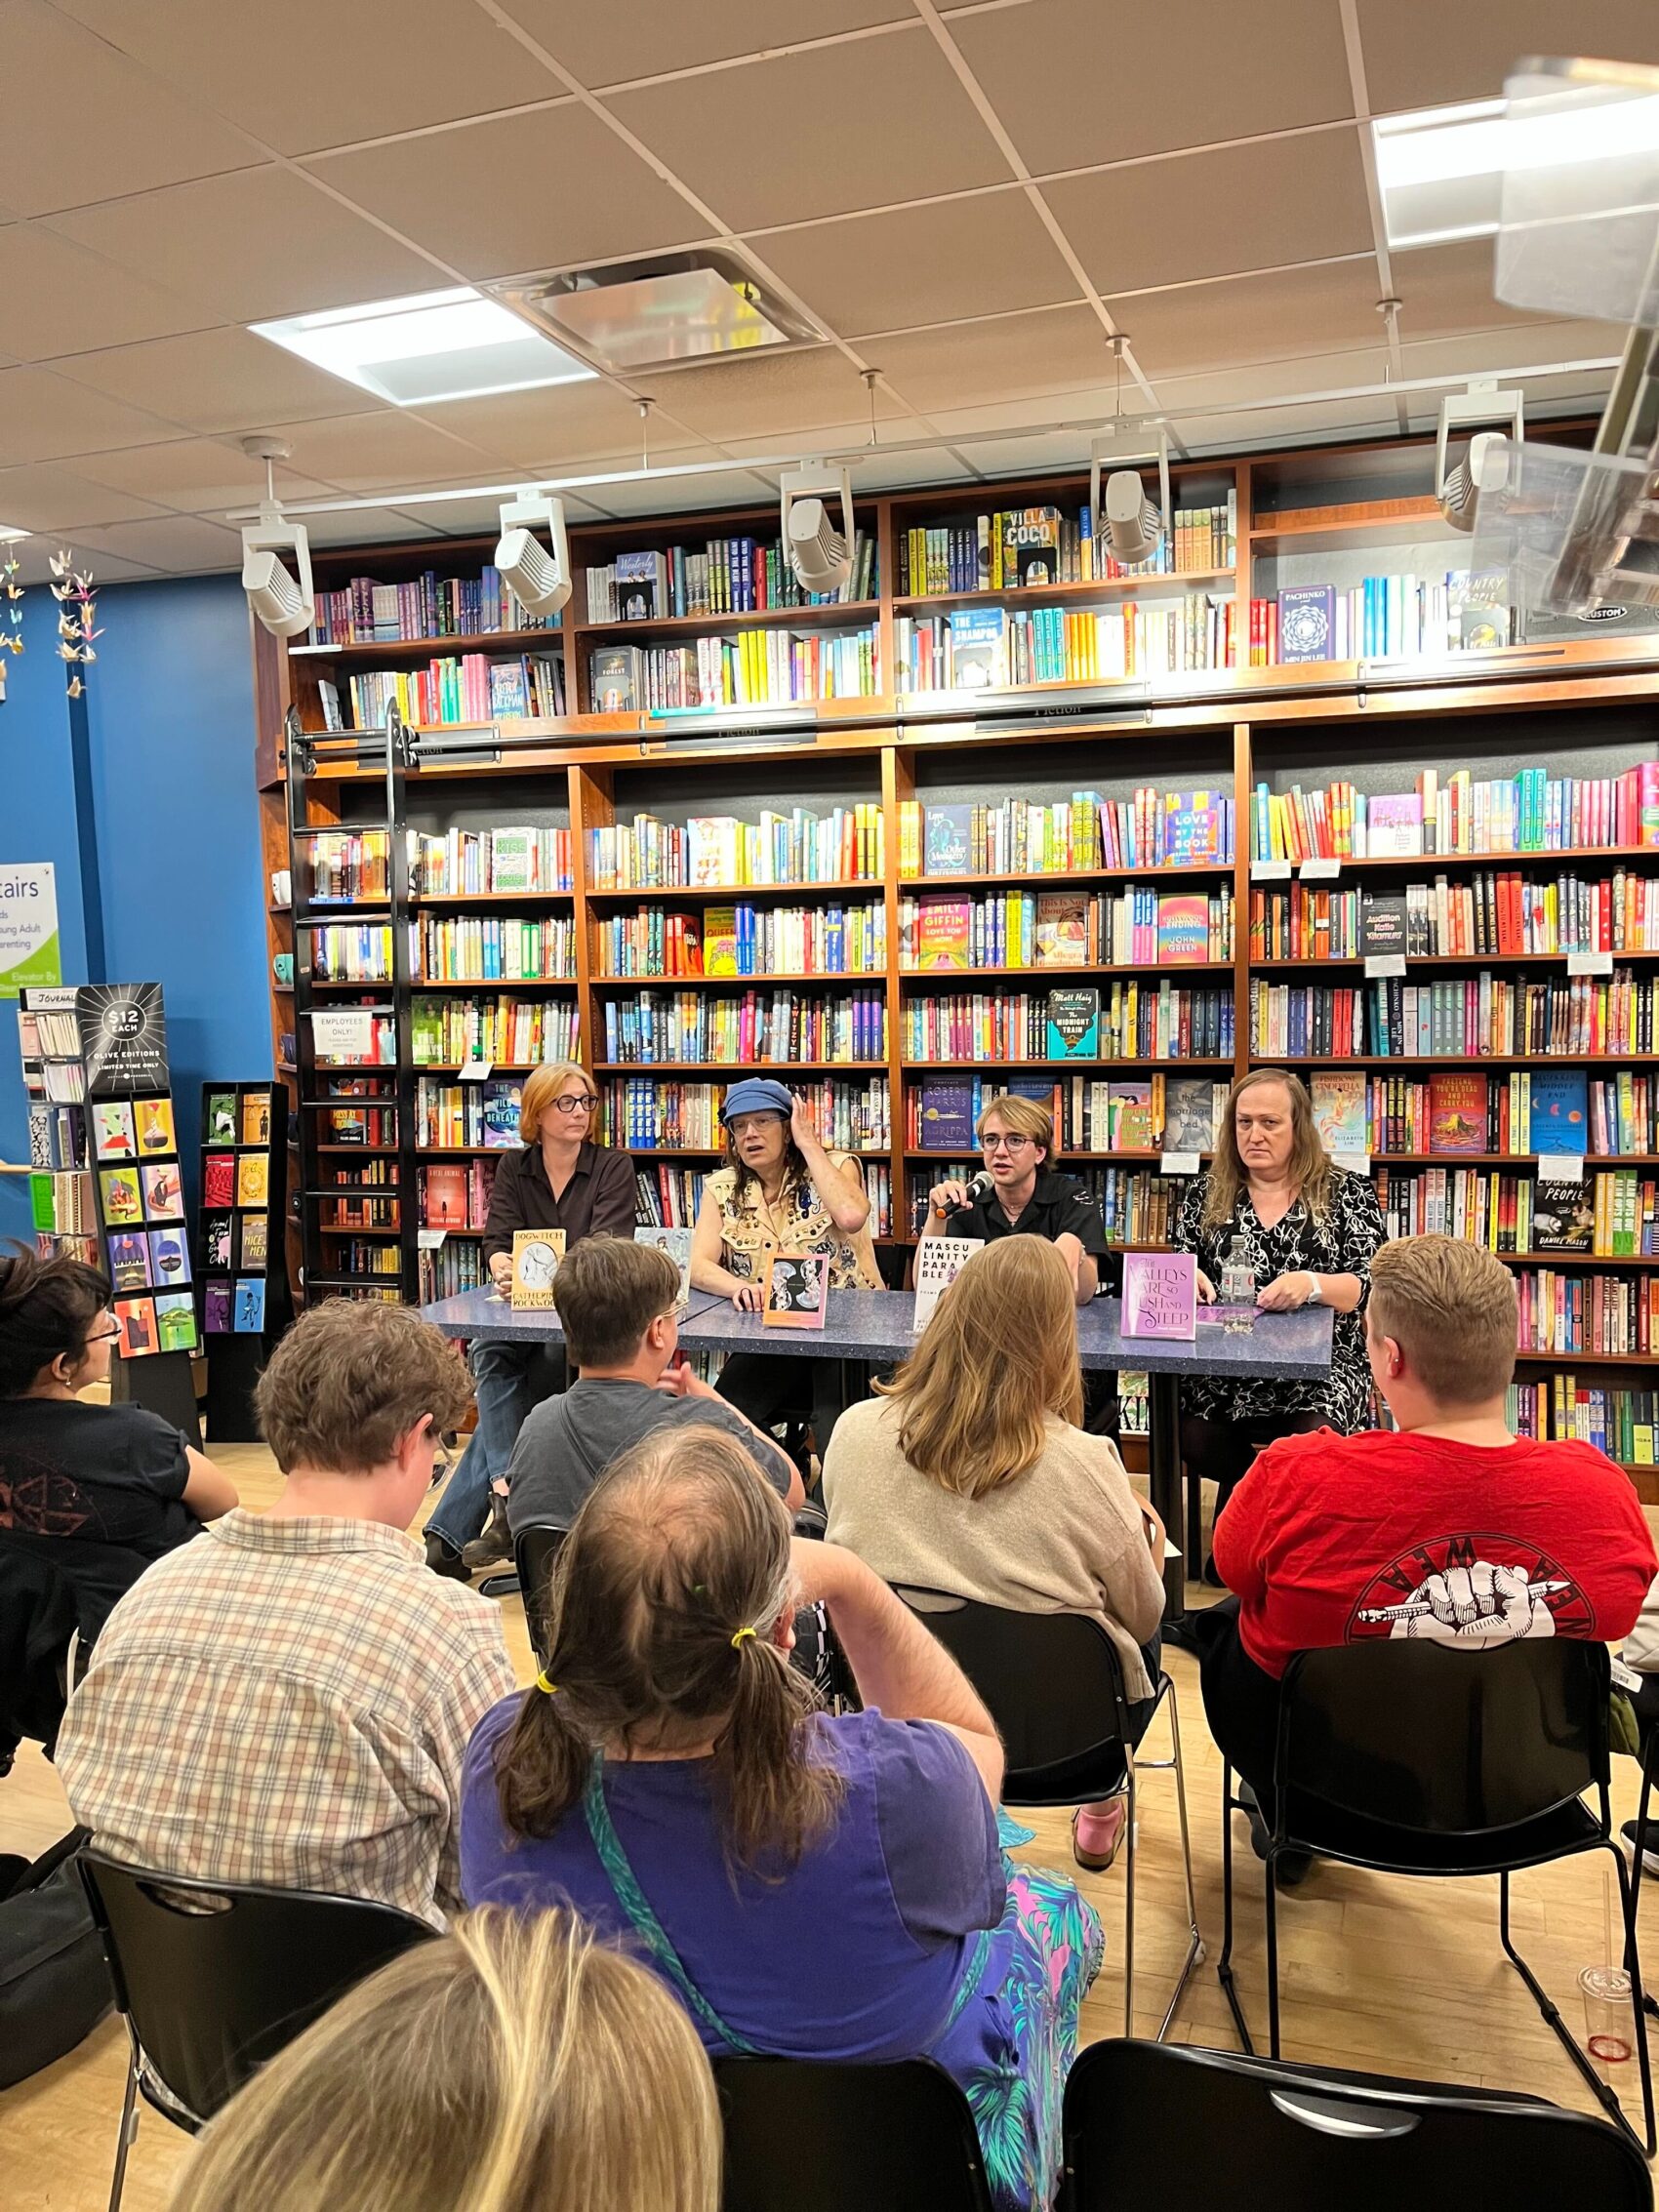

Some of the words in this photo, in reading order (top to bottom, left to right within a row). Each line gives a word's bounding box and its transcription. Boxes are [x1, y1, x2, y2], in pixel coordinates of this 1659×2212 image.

[1010, 513, 1045, 526] VILLA
[1007, 524, 1049, 544] COCO
[620, 556, 654, 572] Westerly
[1285, 591, 1325, 601] PACHINKO
[955, 617, 970, 627] THE
[1175, 814, 1207, 825] LOVE
[498, 843, 527, 853] KISS
[1175, 838, 1208, 849] BOOK
[1040, 899, 1058, 907] This
[927, 905, 960, 915] EMILY
[925, 915, 963, 926] GIFFIN
[1366, 913, 1400, 924] Audition
[20, 923, 41, 934] Adult
[1169, 936, 1194, 945] JOHN
[1168, 944, 1196, 952] GREEN
[46, 972, 57, 983] By
[1054, 992, 1073, 1003] Matt
[1074, 992, 1093, 1005] Haig
[1516, 976, 1525, 1028] ARTIFACTS
[108, 1010, 139, 1024] $12
[1056, 1018, 1090, 1026] MIDNIGHT
[1062, 1026, 1083, 1034] TRAIN
[94, 1051, 119, 1060] OLIVE
[121, 1050, 160, 1059] EDITIONS
[97, 1063, 124, 1071] LIMITED
[495, 1083, 508, 1094] THE
[926, 1087, 967, 1097] ROBERT
[1315, 1082, 1360, 1091] CINDERELLA
[1436, 1084, 1457, 1093] YOU'RE
[492, 1098, 511, 1109] WILD
[928, 1097, 966, 1107] HARRIS
[1181, 1094, 1195, 1104] the
[1439, 1099, 1459, 1107] CARRY
[1460, 1099, 1475, 1107] YOU
[486, 1111, 520, 1123] BENEATH
[1167, 1107, 1211, 1118] marriage
[1180, 1119, 1198, 1129] bed
[925, 1125, 969, 1139] AGRIPPA
[445, 1168, 462, 1177] ANIMAL
[1614, 1179, 1624, 1197] ALAN
[1626, 1179, 1636, 1197] ALAN
[1545, 1187, 1584, 1201] PEOPLE
[1614, 1198, 1624, 1216] OPTS
[1626, 1198, 1636, 1216] OPTS
[1614, 1218, 1624, 1231] OUT
[1626, 1218, 1636, 1231] OUT
[515, 1231, 563, 1241] DOGWITCH
[1538, 1235, 1563, 1246] DANIEL
[1565, 1237, 1589, 1247] MASON
[924, 1242, 969, 1252] MASCU
[923, 1252, 969, 1262] LINITY
[923, 1261, 956, 1269] PARA
[922, 1270, 944, 1279] BLE
[1129, 1268, 1188, 1284] VALLEYS
[1142, 1282, 1165, 1295] ARE
[513, 1292, 554, 1301] CATHERIN
[513, 1300, 554, 1311] ROCKWOO
[1134, 1297, 1163, 1313] LUSH
[1165, 1301, 1181, 1310] AND
[1144, 1310, 1189, 1328] STEEP
